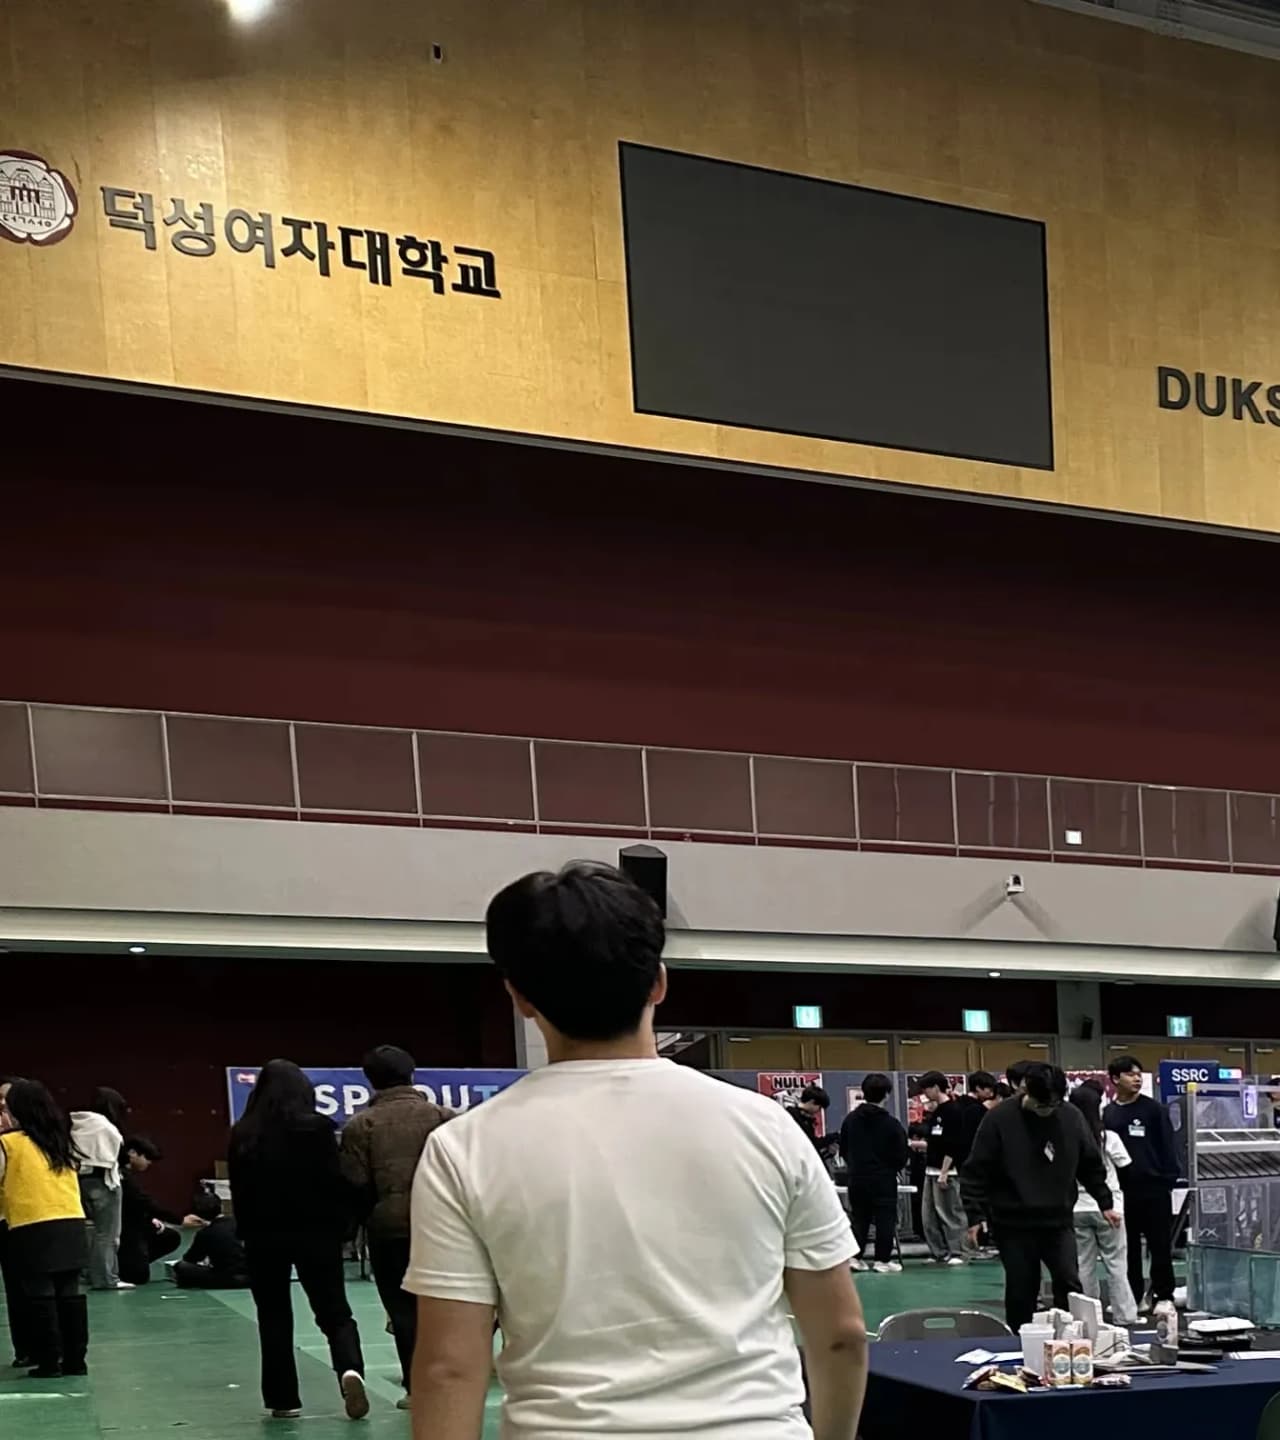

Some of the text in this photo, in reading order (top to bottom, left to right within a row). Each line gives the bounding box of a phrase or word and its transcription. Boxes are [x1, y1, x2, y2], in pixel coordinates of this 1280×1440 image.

[101, 186, 502, 299] 덕성여자대학교
[1171, 1068, 1209, 1082] SSRC
[773, 1076, 806, 1089] NULL
